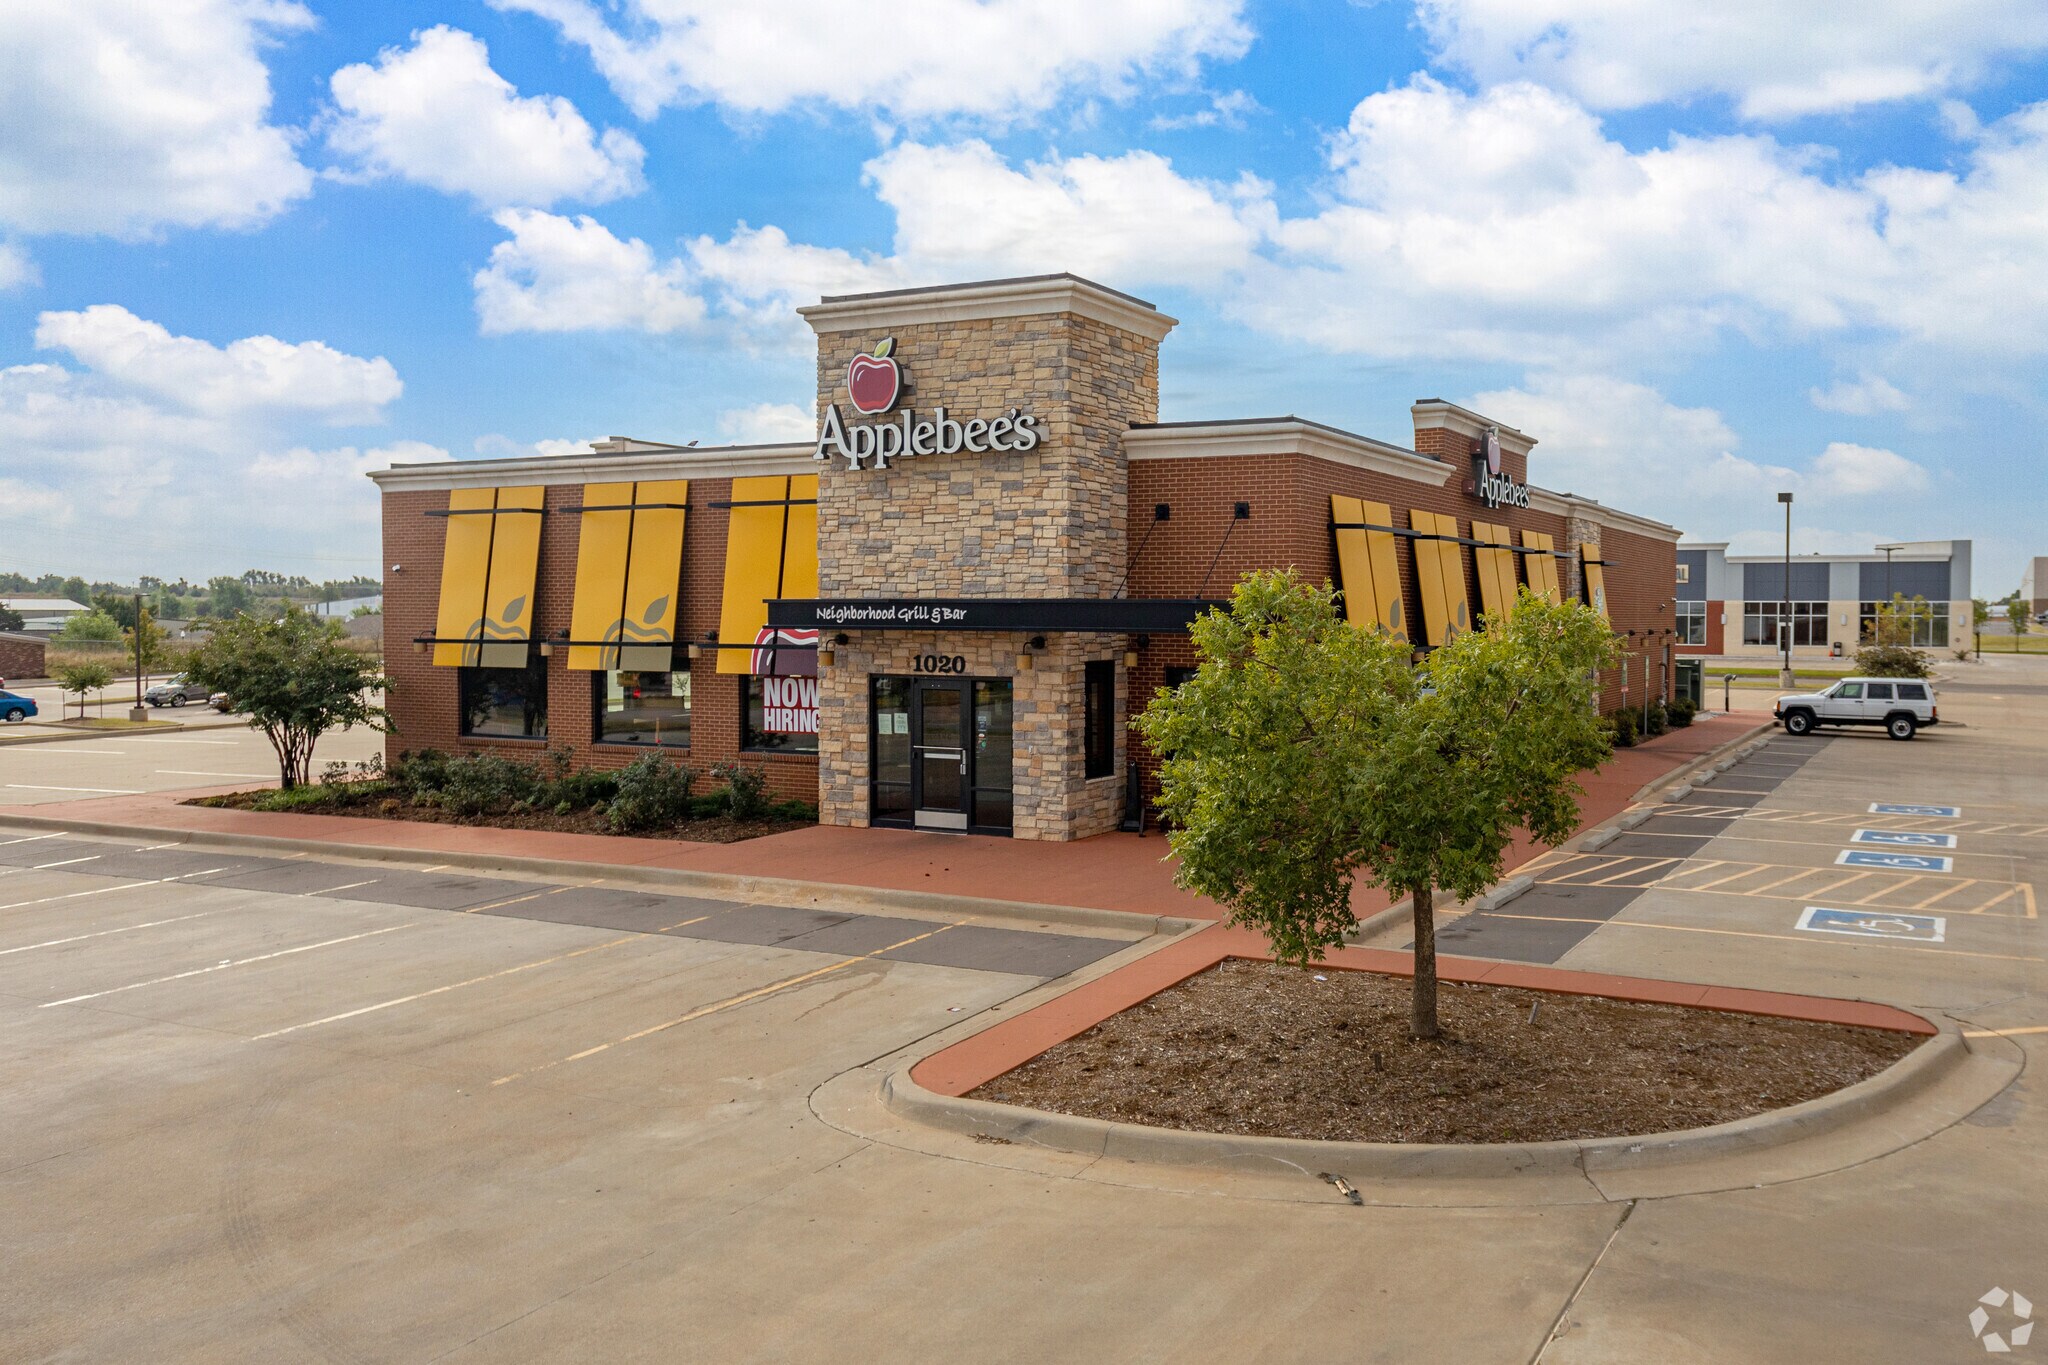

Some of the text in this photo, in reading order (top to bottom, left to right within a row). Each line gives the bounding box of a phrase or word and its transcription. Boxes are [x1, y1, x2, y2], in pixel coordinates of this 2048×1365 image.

[813, 404, 1039, 470] Applebee's
[816, 605, 967, 623] Neighborhood Grill & Bar
[913, 654, 966, 674] 1020
[764, 678, 819, 707] NOW
[764, 708, 820, 733] HIRING
